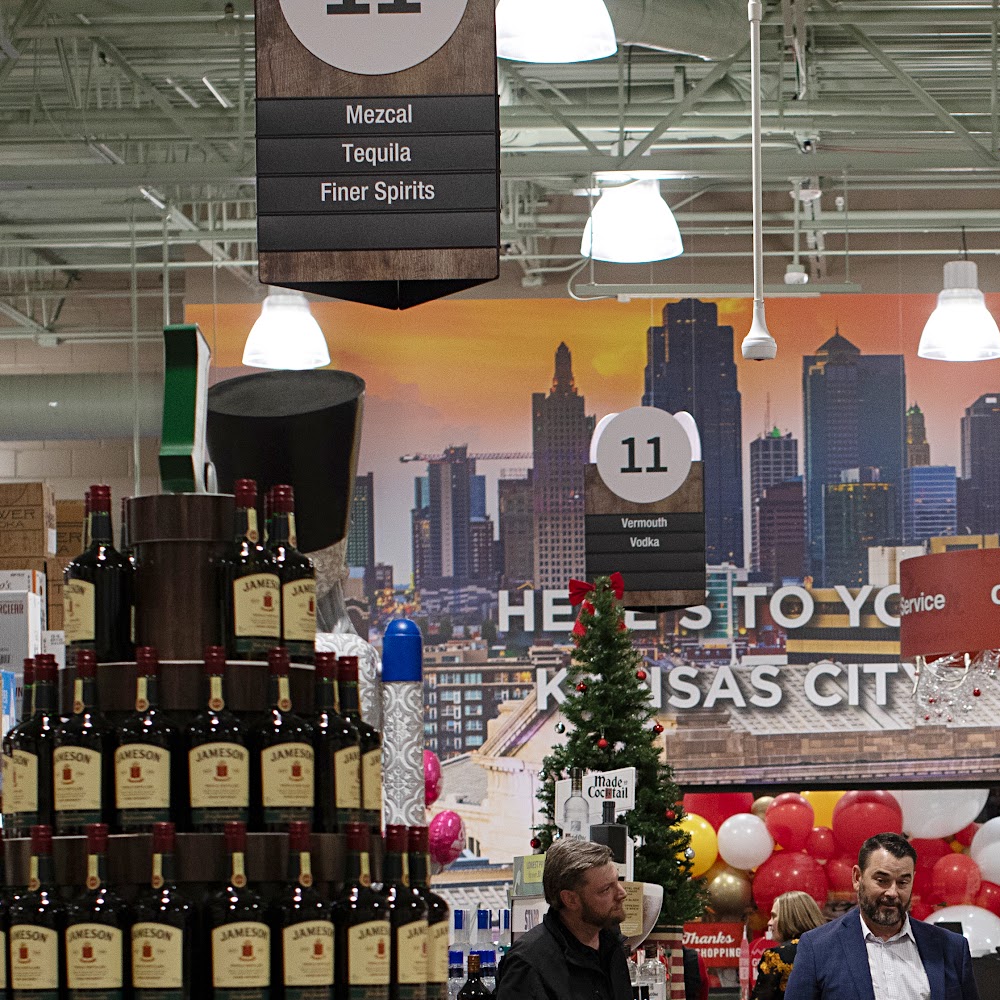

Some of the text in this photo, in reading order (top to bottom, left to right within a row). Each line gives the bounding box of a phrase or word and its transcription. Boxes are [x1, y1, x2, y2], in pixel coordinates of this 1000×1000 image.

[346, 104, 413, 124] Mezcal
[342, 143, 411, 166] Tequila
[321, 181, 435, 204] Finer Spirits
[620, 436, 668, 473] 11
[621, 517, 668, 529] Vermouth
[630, 536, 660, 548] Vodka
[732, 584, 815, 629] TO
[594, 776, 622, 788] Made
[682, 931, 735, 945] Thanks
